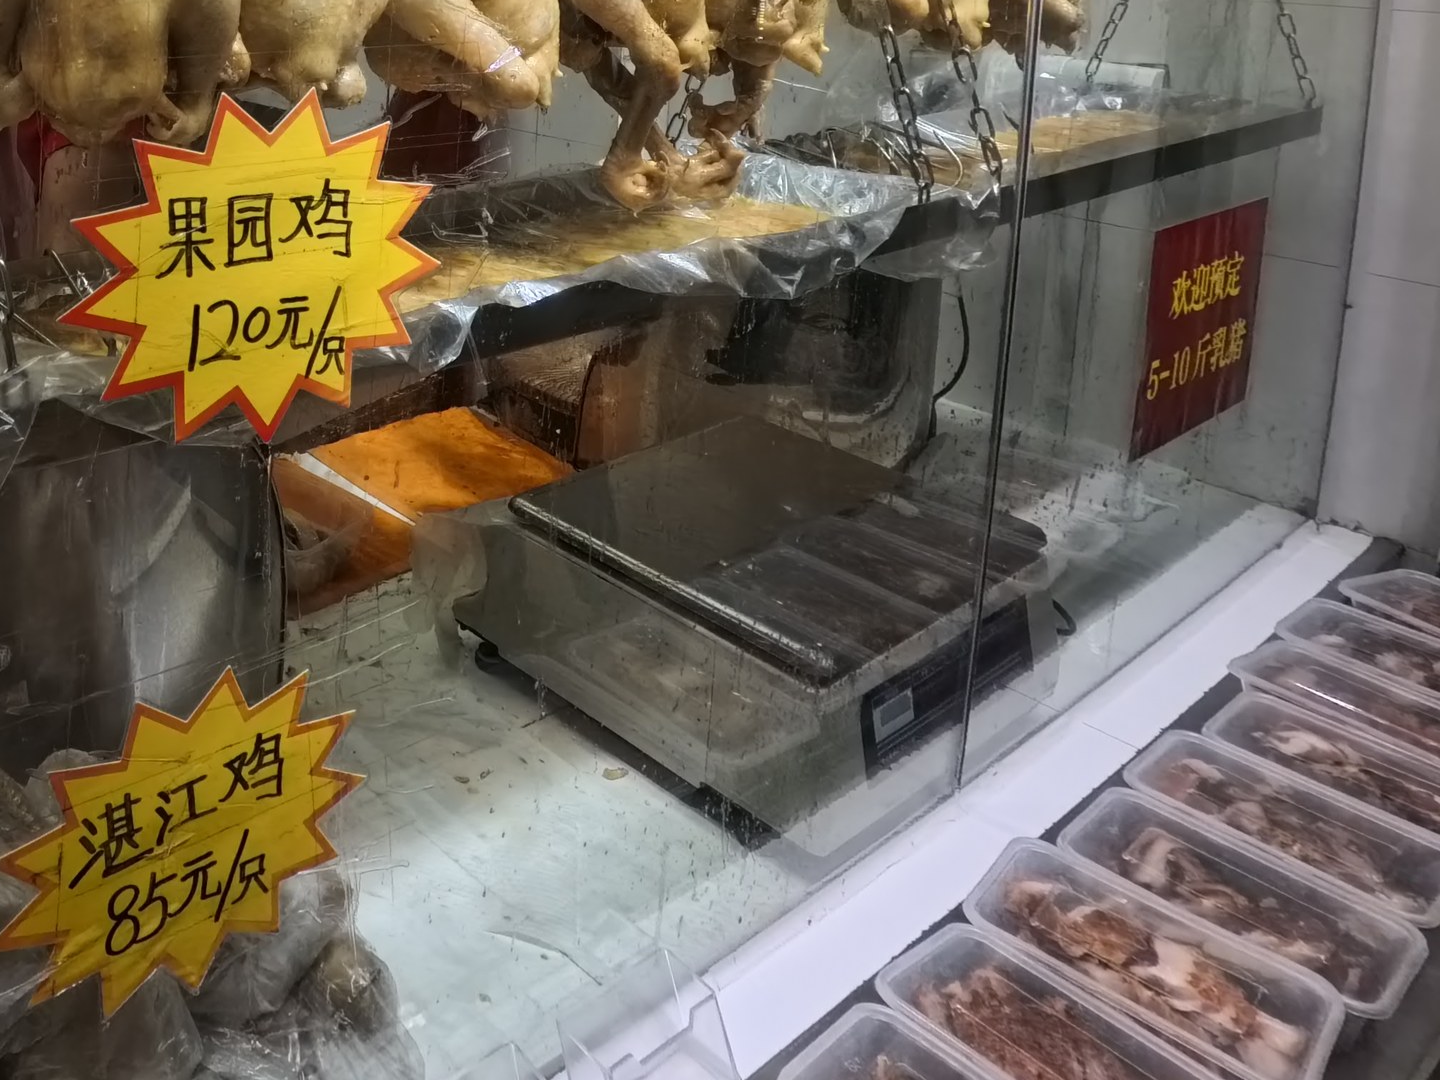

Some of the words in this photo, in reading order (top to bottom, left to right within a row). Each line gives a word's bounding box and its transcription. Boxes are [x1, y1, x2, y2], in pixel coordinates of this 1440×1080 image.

[155, 178, 352, 279] 果园鸡
[187, 286, 346, 379] 120元/只
[1168, 251, 1244, 319] 欢迎预定
[69, 733, 285, 889] 湛江鸡
[105, 828, 270, 957] 85元/只
